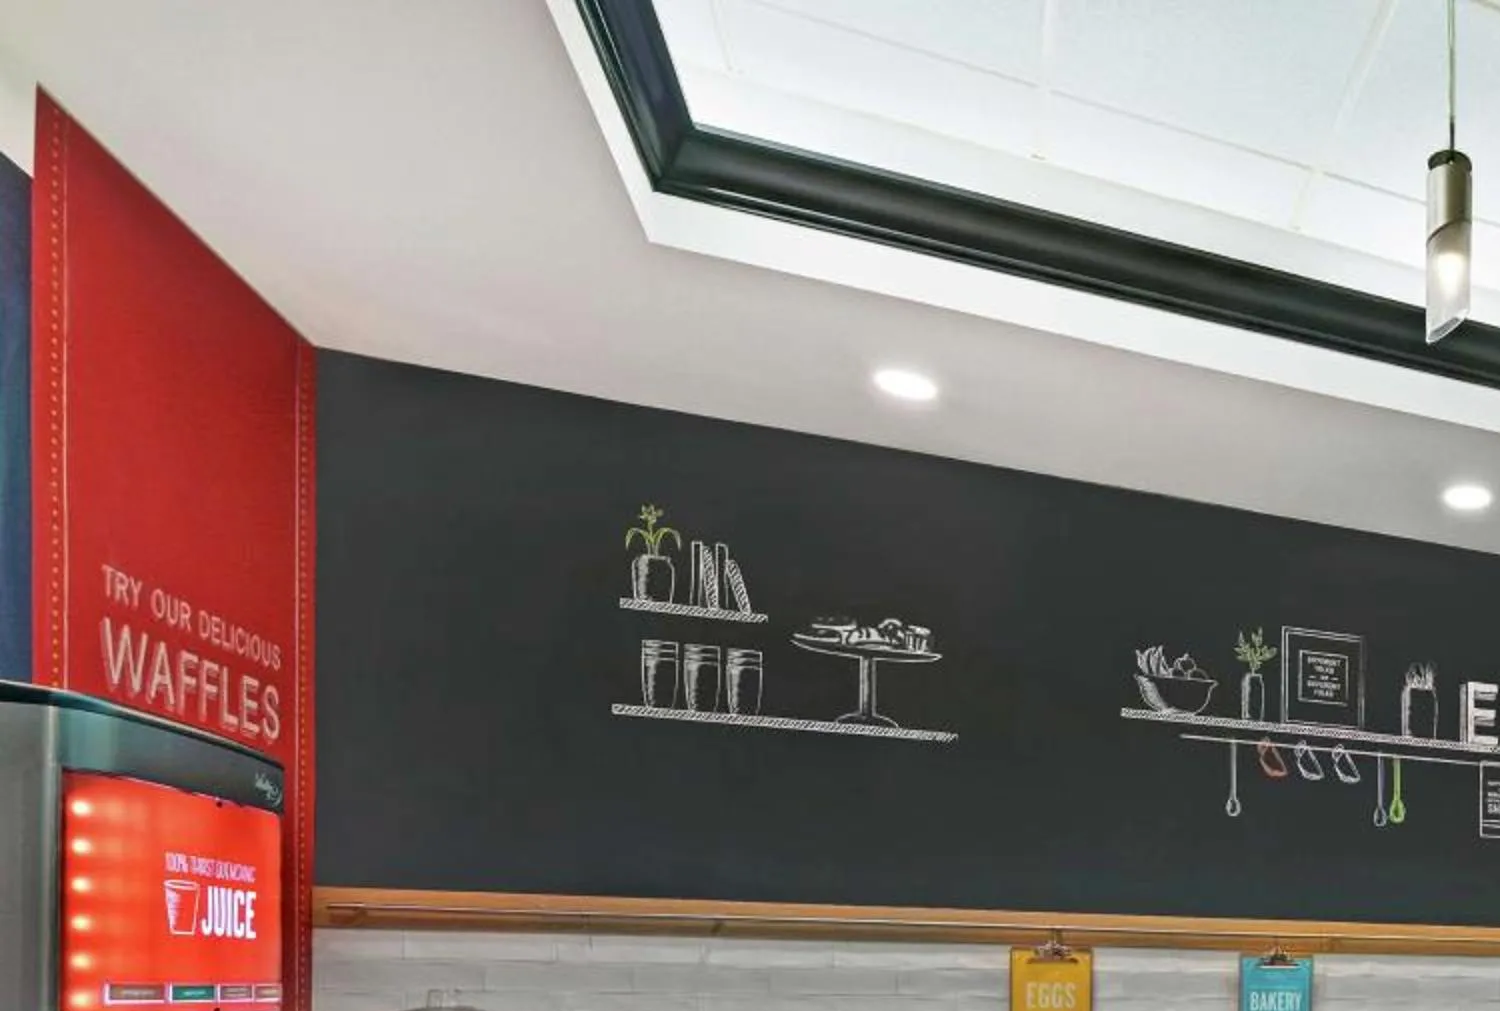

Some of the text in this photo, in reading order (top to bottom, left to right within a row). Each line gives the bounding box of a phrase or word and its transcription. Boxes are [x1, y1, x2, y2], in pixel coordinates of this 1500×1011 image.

[103, 563, 281, 671] TRY OUR DELICIOUS
[102, 616, 280, 745] WAFFLES
[201, 885, 257, 939] JUICE
[1026, 982, 1076, 1009] EGGS
